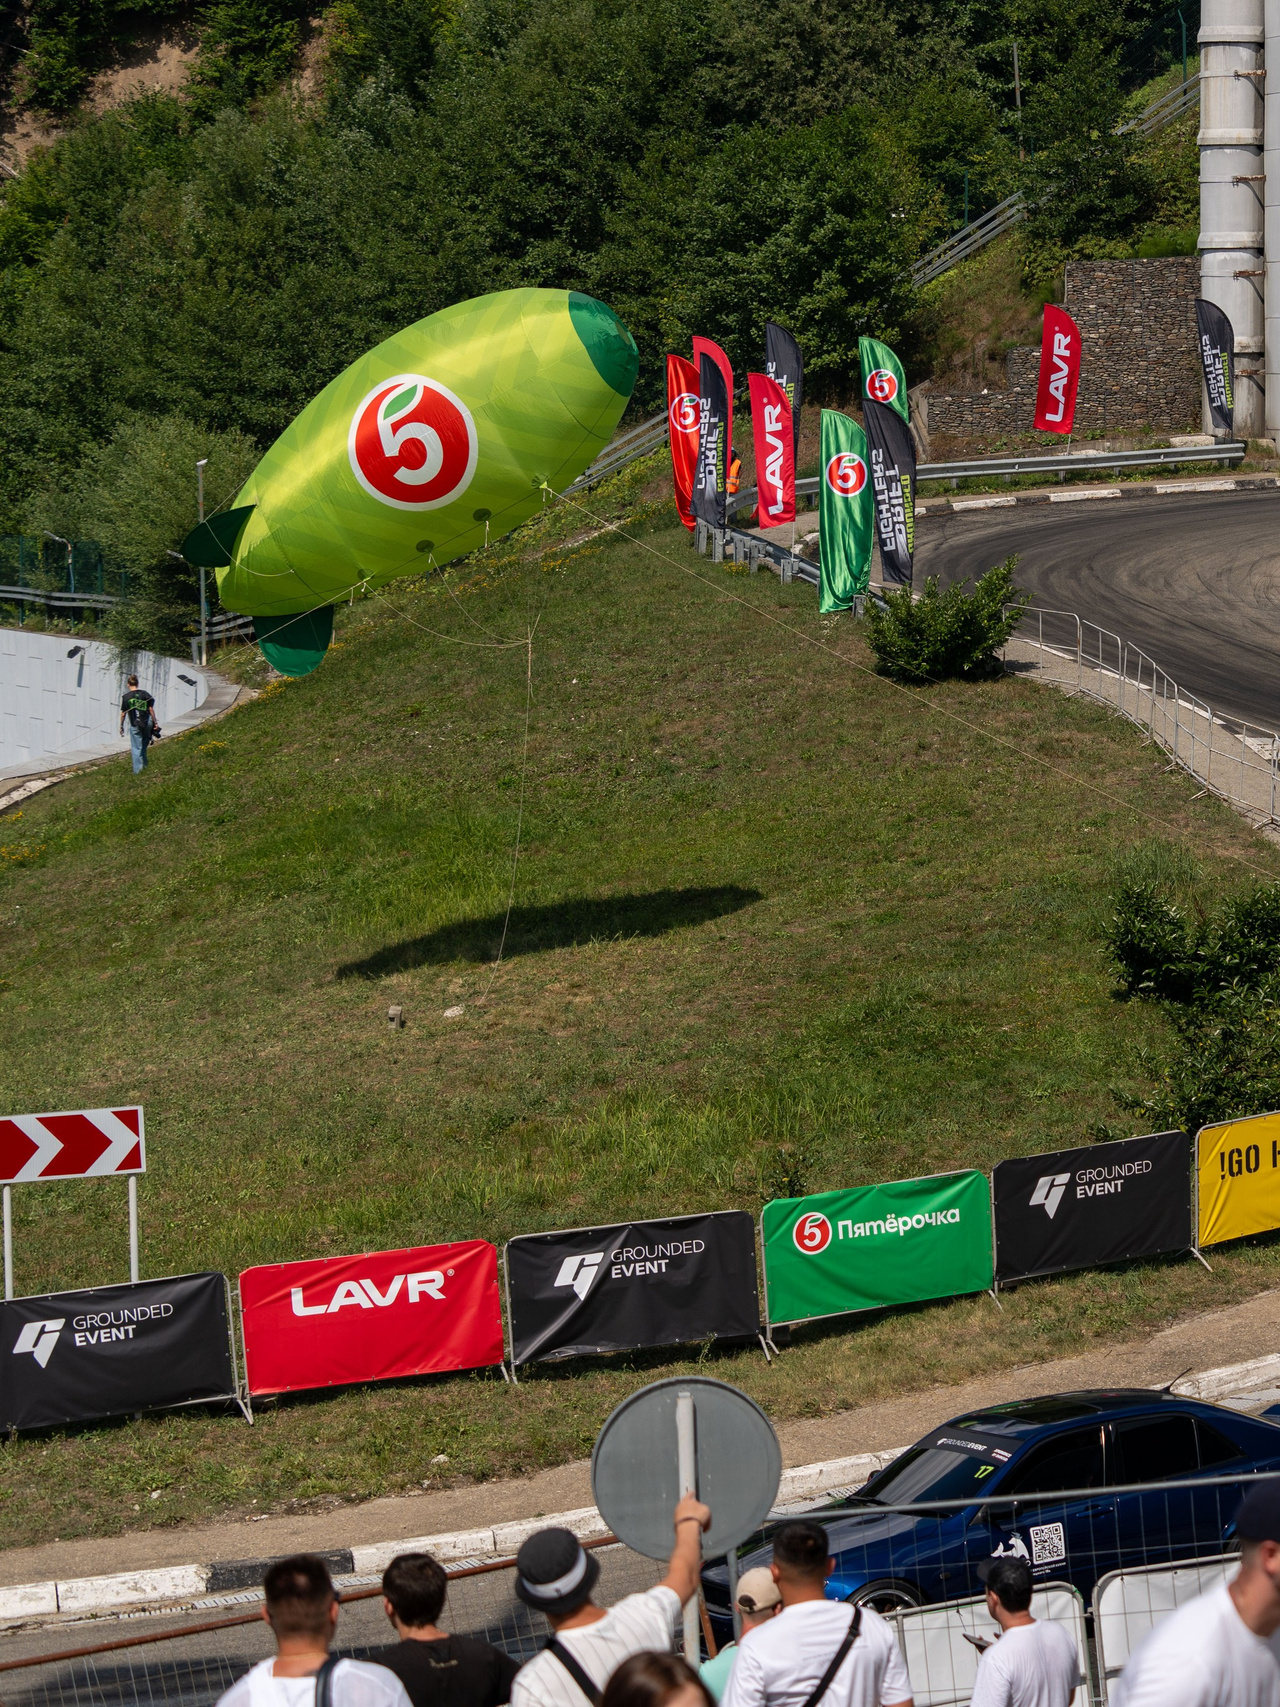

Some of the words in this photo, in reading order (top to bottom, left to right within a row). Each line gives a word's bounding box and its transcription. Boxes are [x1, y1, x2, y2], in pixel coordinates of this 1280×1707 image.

[377, 383, 444, 486] 5
[1076, 1160, 1152, 1183] GROUNDED
[1220, 1144, 1260, 1180] !GO
[1076, 1180, 1124, 1199] EVENT
[838, 1208, 960, 1239] Пятёрочка
[611, 1240, 705, 1262] GROUNDED
[611, 1260, 669, 1279] EVENT
[291, 1270, 446, 1316] LAVR
[72, 1303, 173, 1330] GROUNDED
[74, 1325, 136, 1347] EVENT
[974, 1465, 994, 1479] 17
